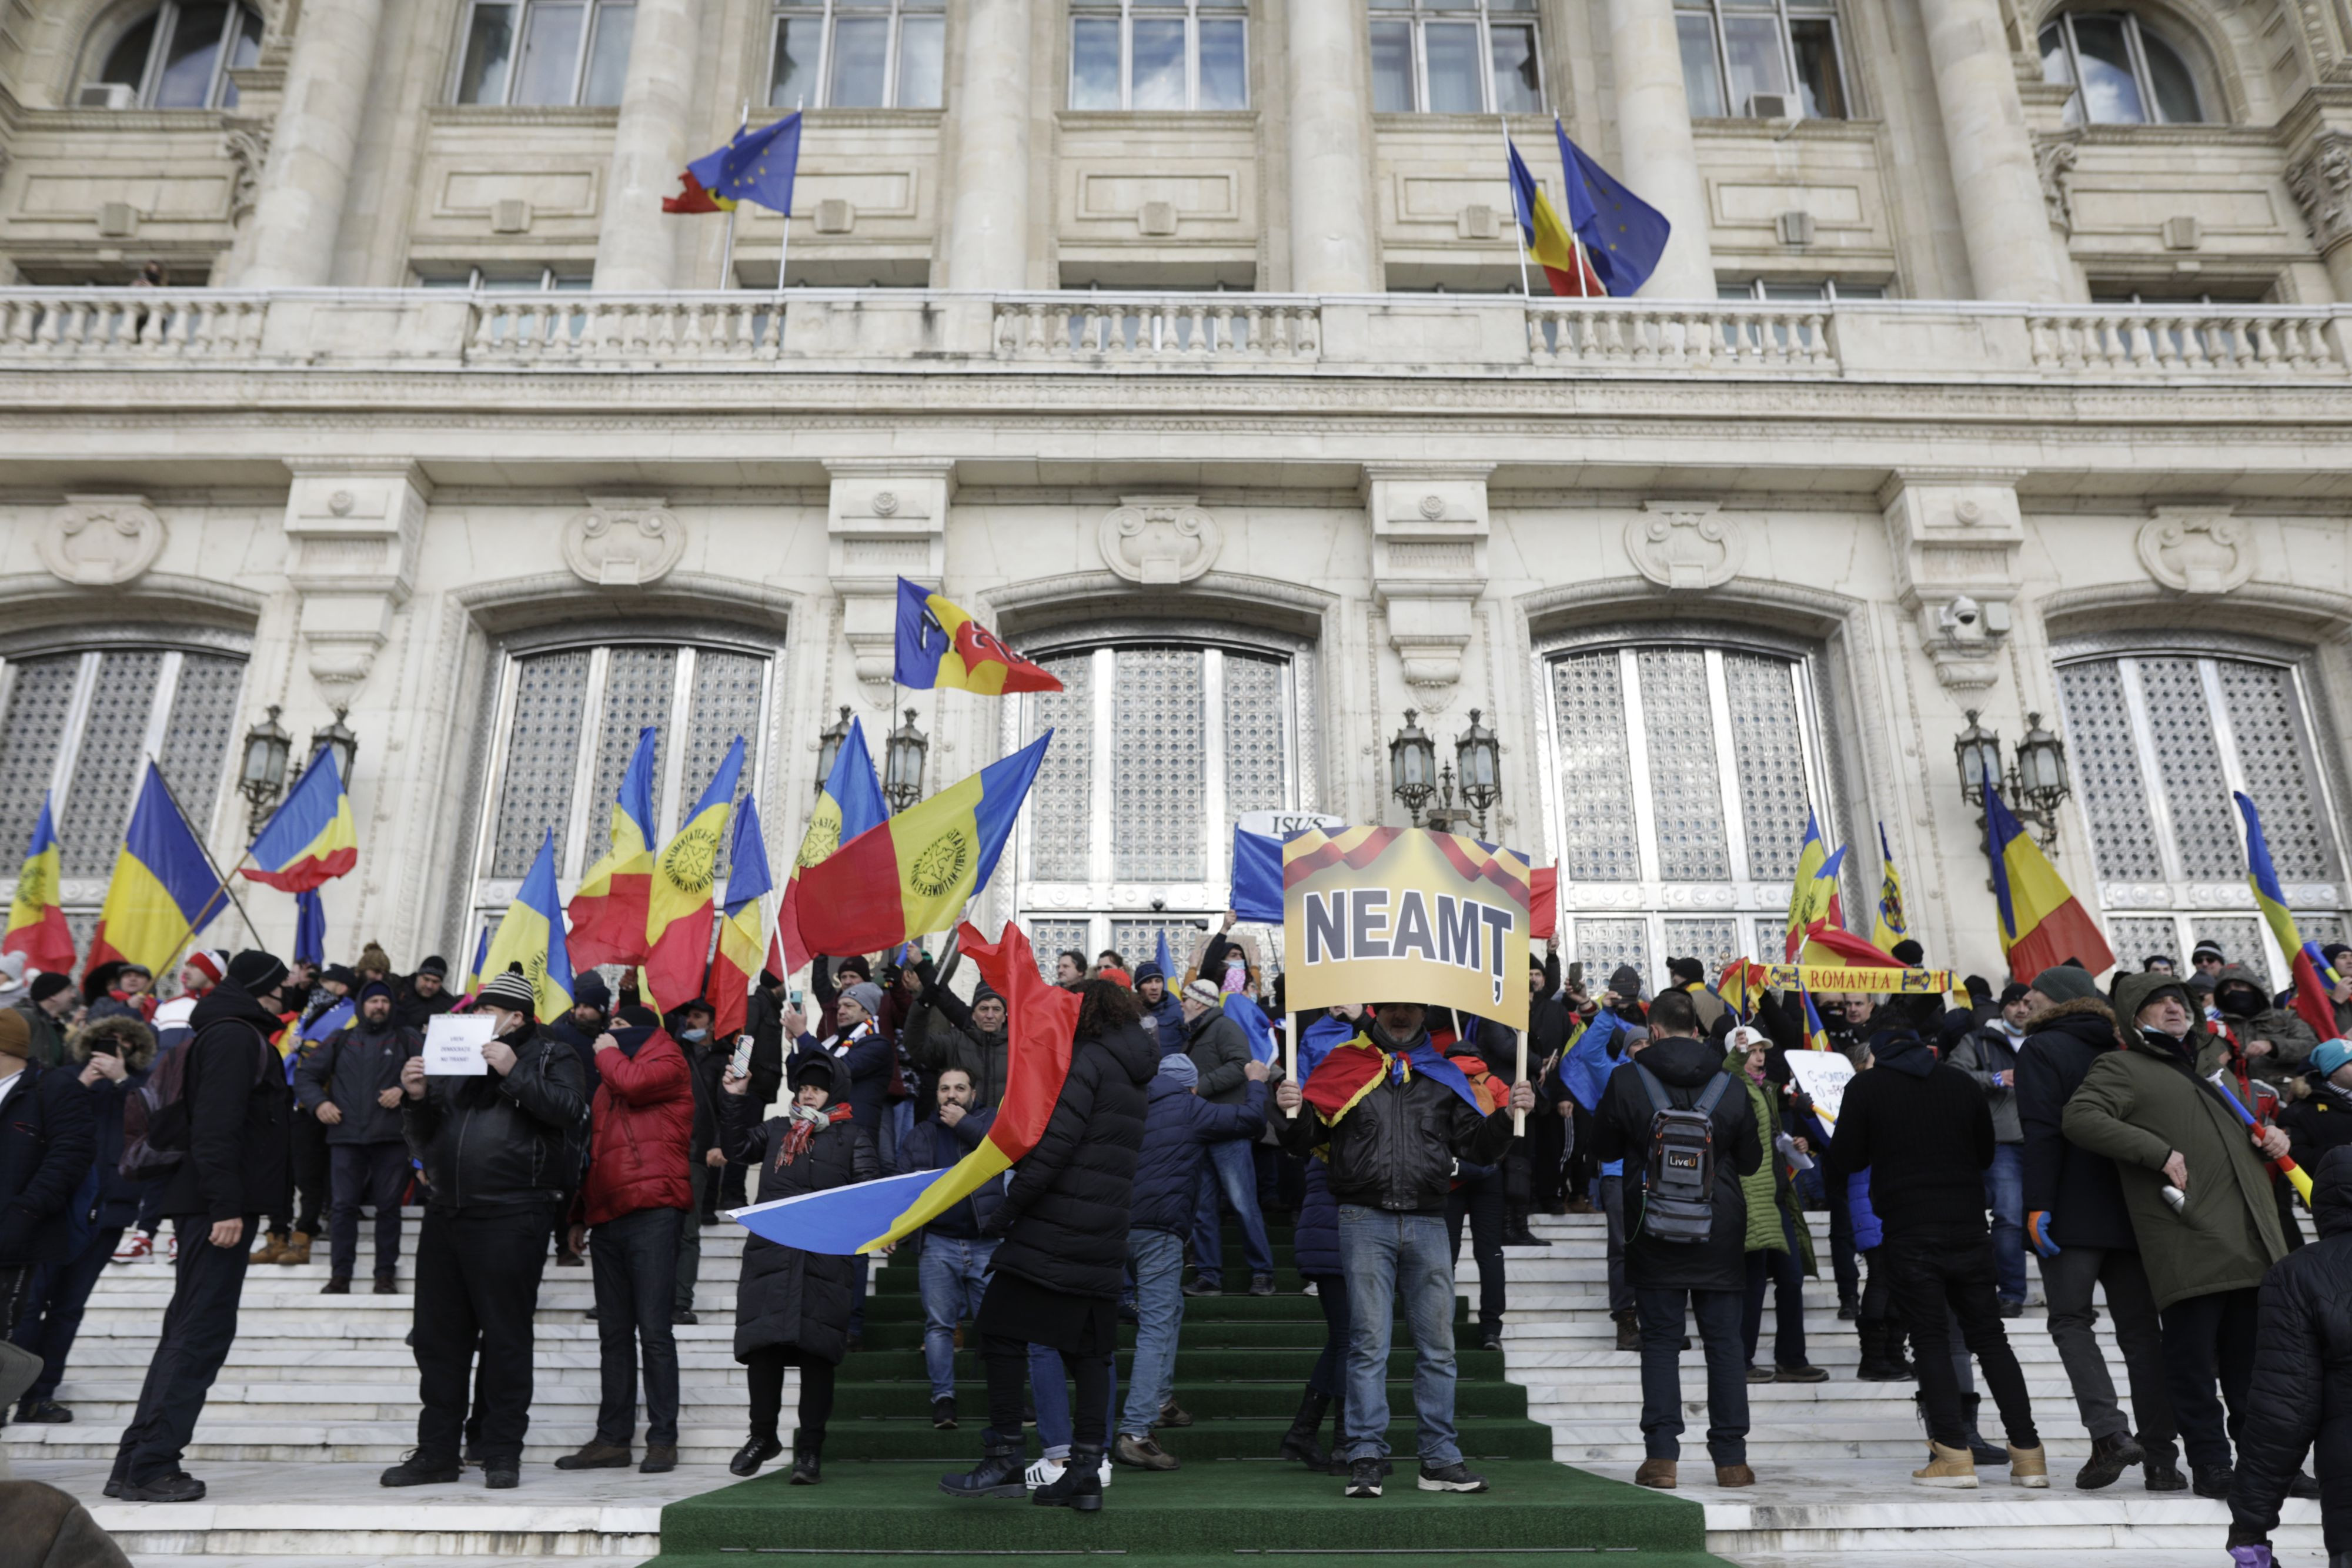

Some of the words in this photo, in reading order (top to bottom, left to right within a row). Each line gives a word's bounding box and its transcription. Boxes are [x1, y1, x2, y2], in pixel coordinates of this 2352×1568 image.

[1271, 816, 1327, 834] ISUS
[1810, 969, 1891, 989] ROMANIA
[1670, 1155, 1696, 1167] LiveU
